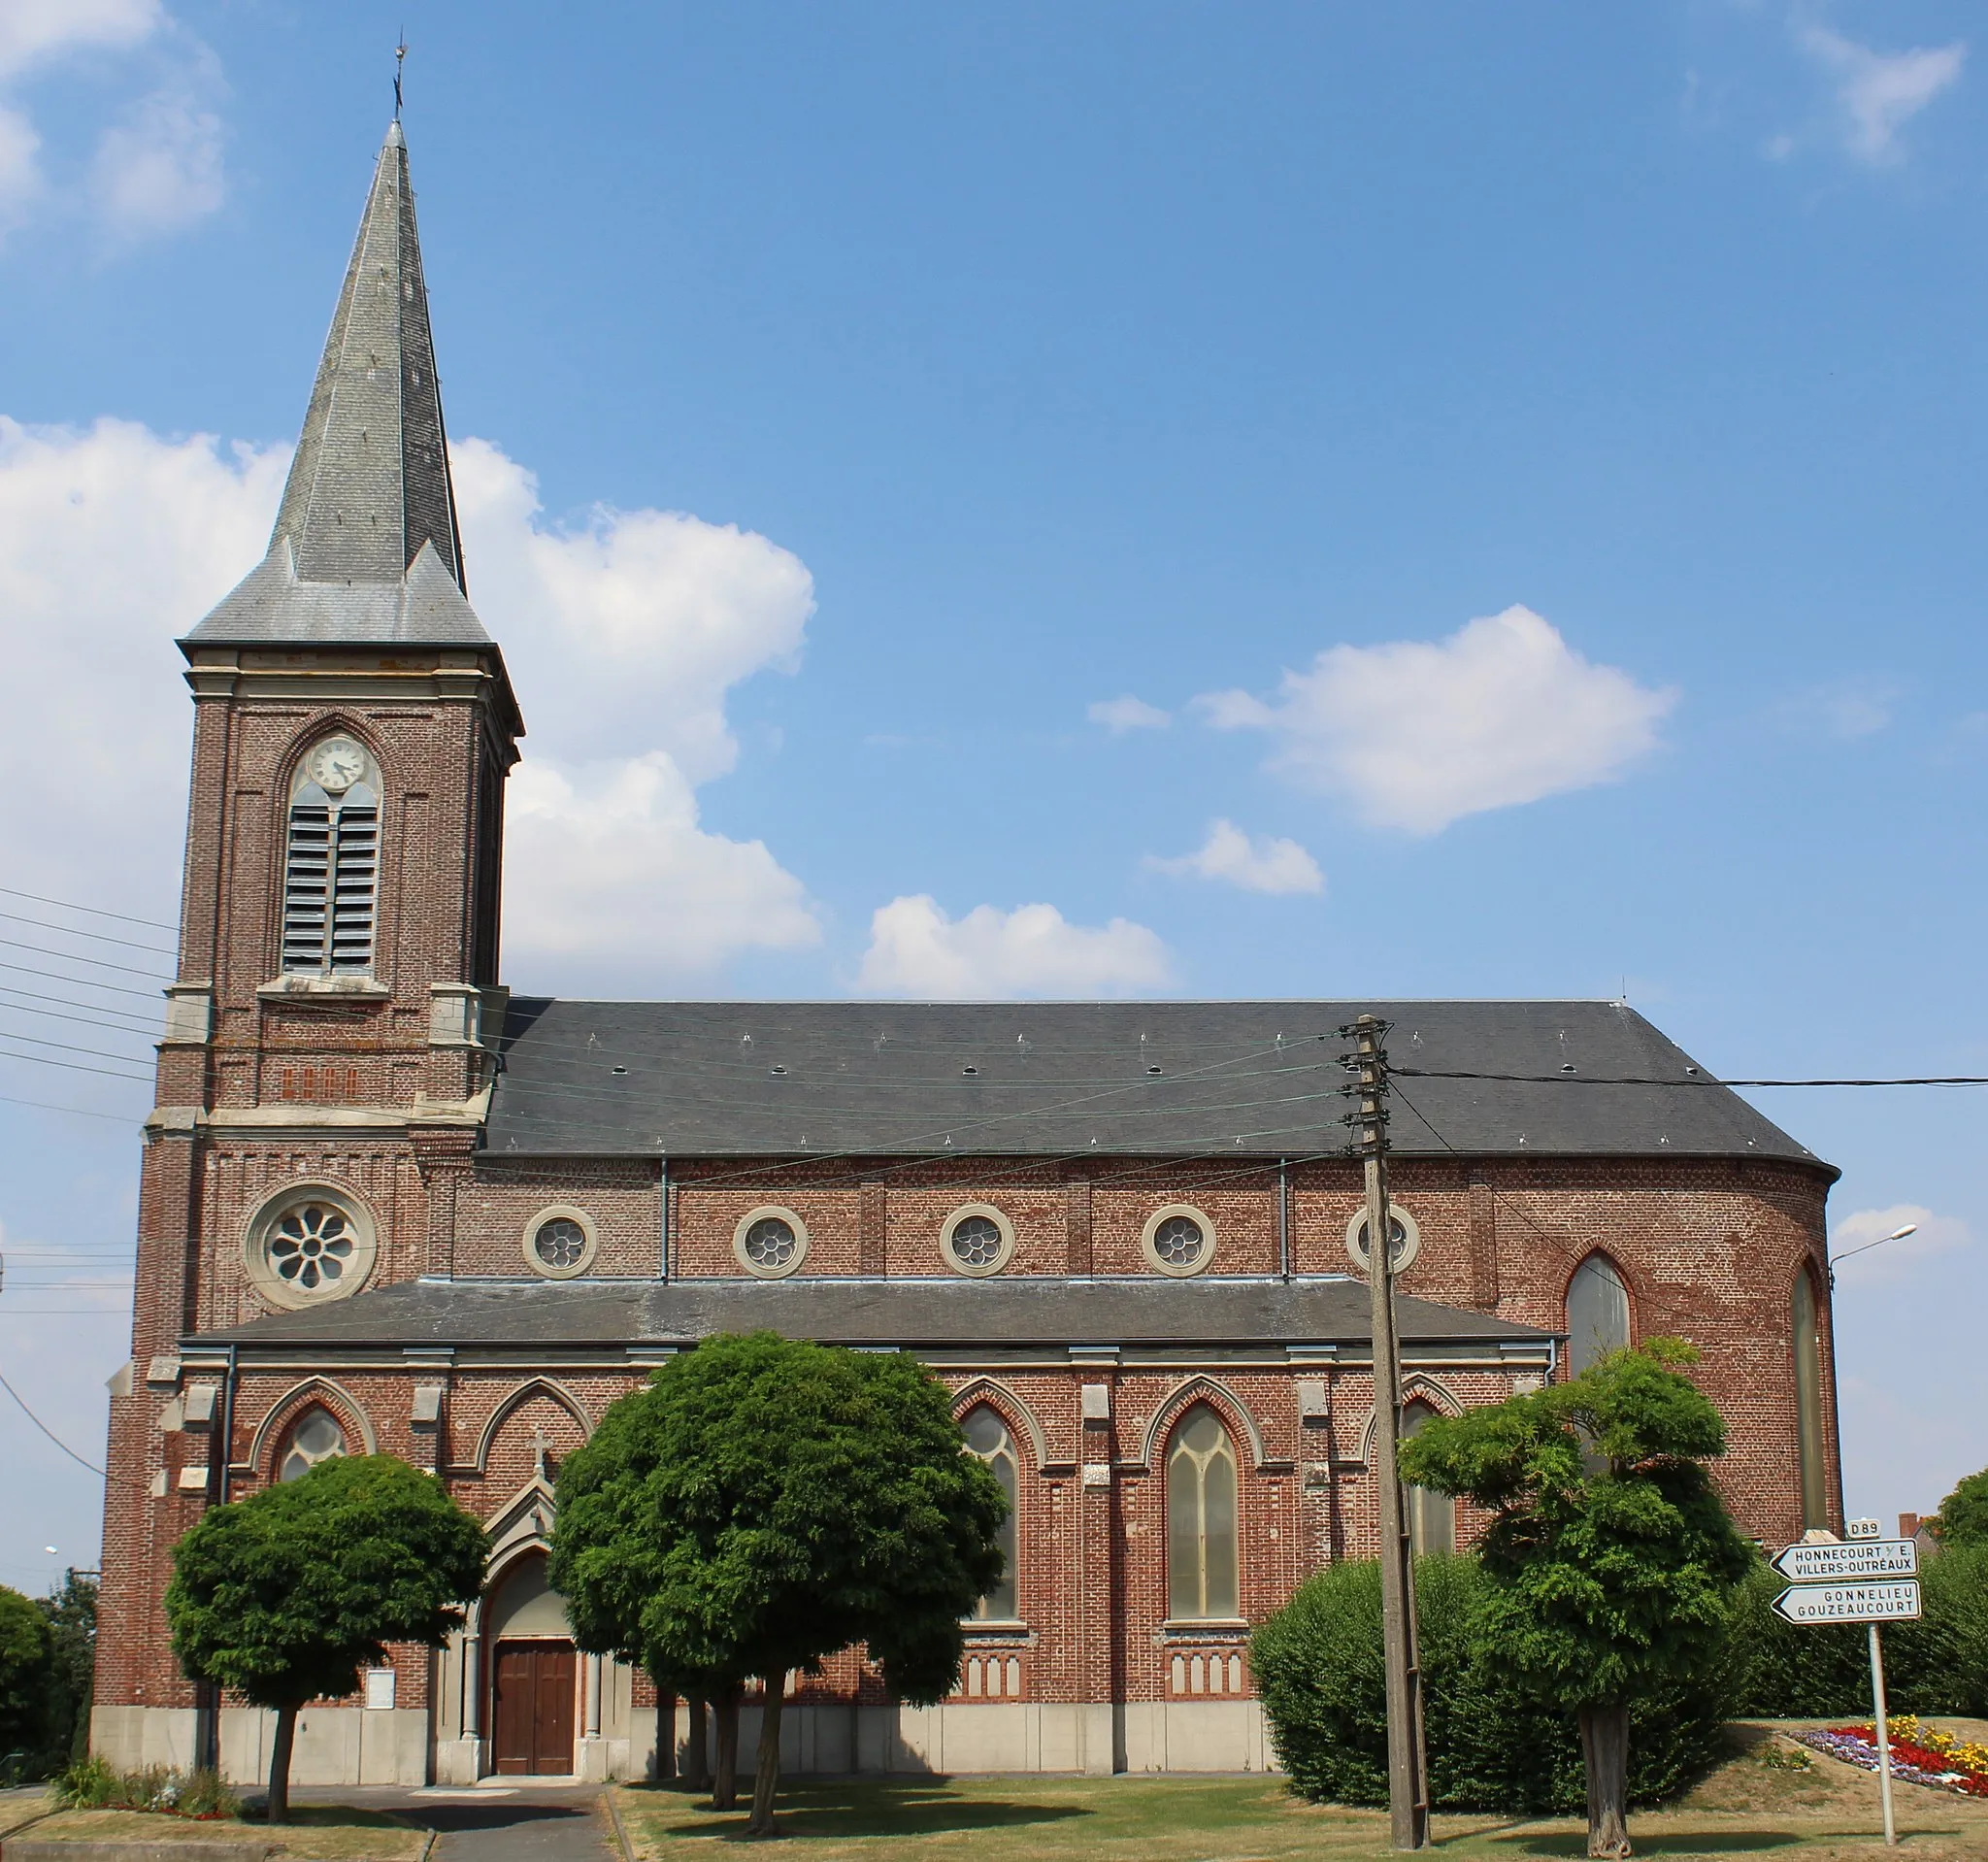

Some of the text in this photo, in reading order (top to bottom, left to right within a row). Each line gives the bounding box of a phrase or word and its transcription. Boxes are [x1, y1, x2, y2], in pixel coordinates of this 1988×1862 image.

[1851, 1523, 1877, 1534] D 89
[1796, 1547, 1881, 1561] HONNECOURT
[1900, 1546, 1911, 1556] E.
[1796, 1558, 1911, 1575] VILLERS-OUTRÉAUX
[1824, 1587, 1912, 1602] GONNELIEU
[1798, 1601, 1913, 1616] GOUZEAUCOURT
